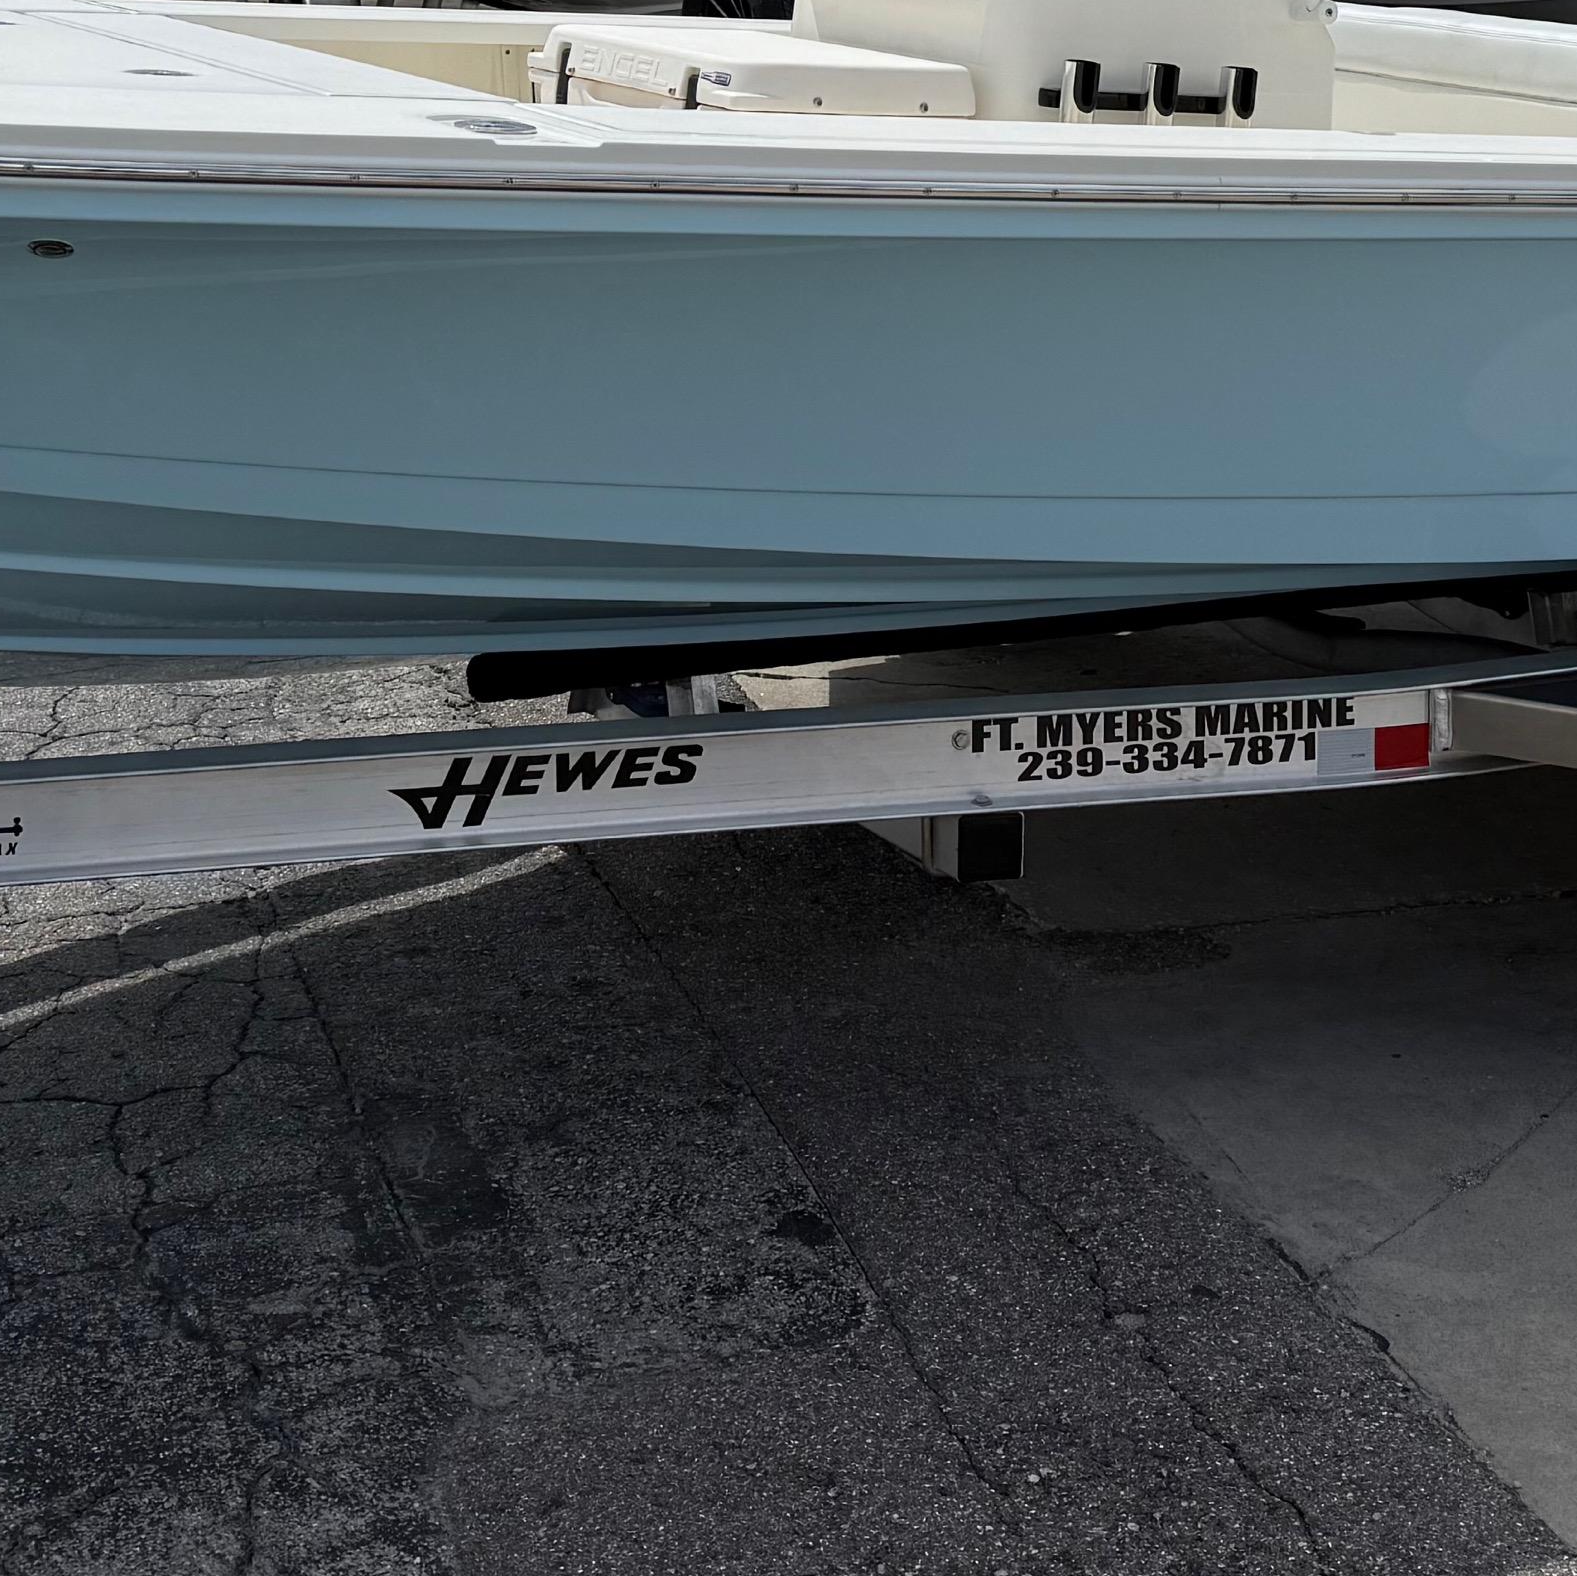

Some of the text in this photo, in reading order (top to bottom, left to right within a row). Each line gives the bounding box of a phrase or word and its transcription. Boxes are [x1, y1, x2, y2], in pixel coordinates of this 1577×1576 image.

[578, 44, 669, 88] ENGEL
[971, 696, 1356, 753] FT. MYERS MARINE
[1017, 730, 1317, 782] 239-334-7871
[388, 744, 704, 830] HEWES
